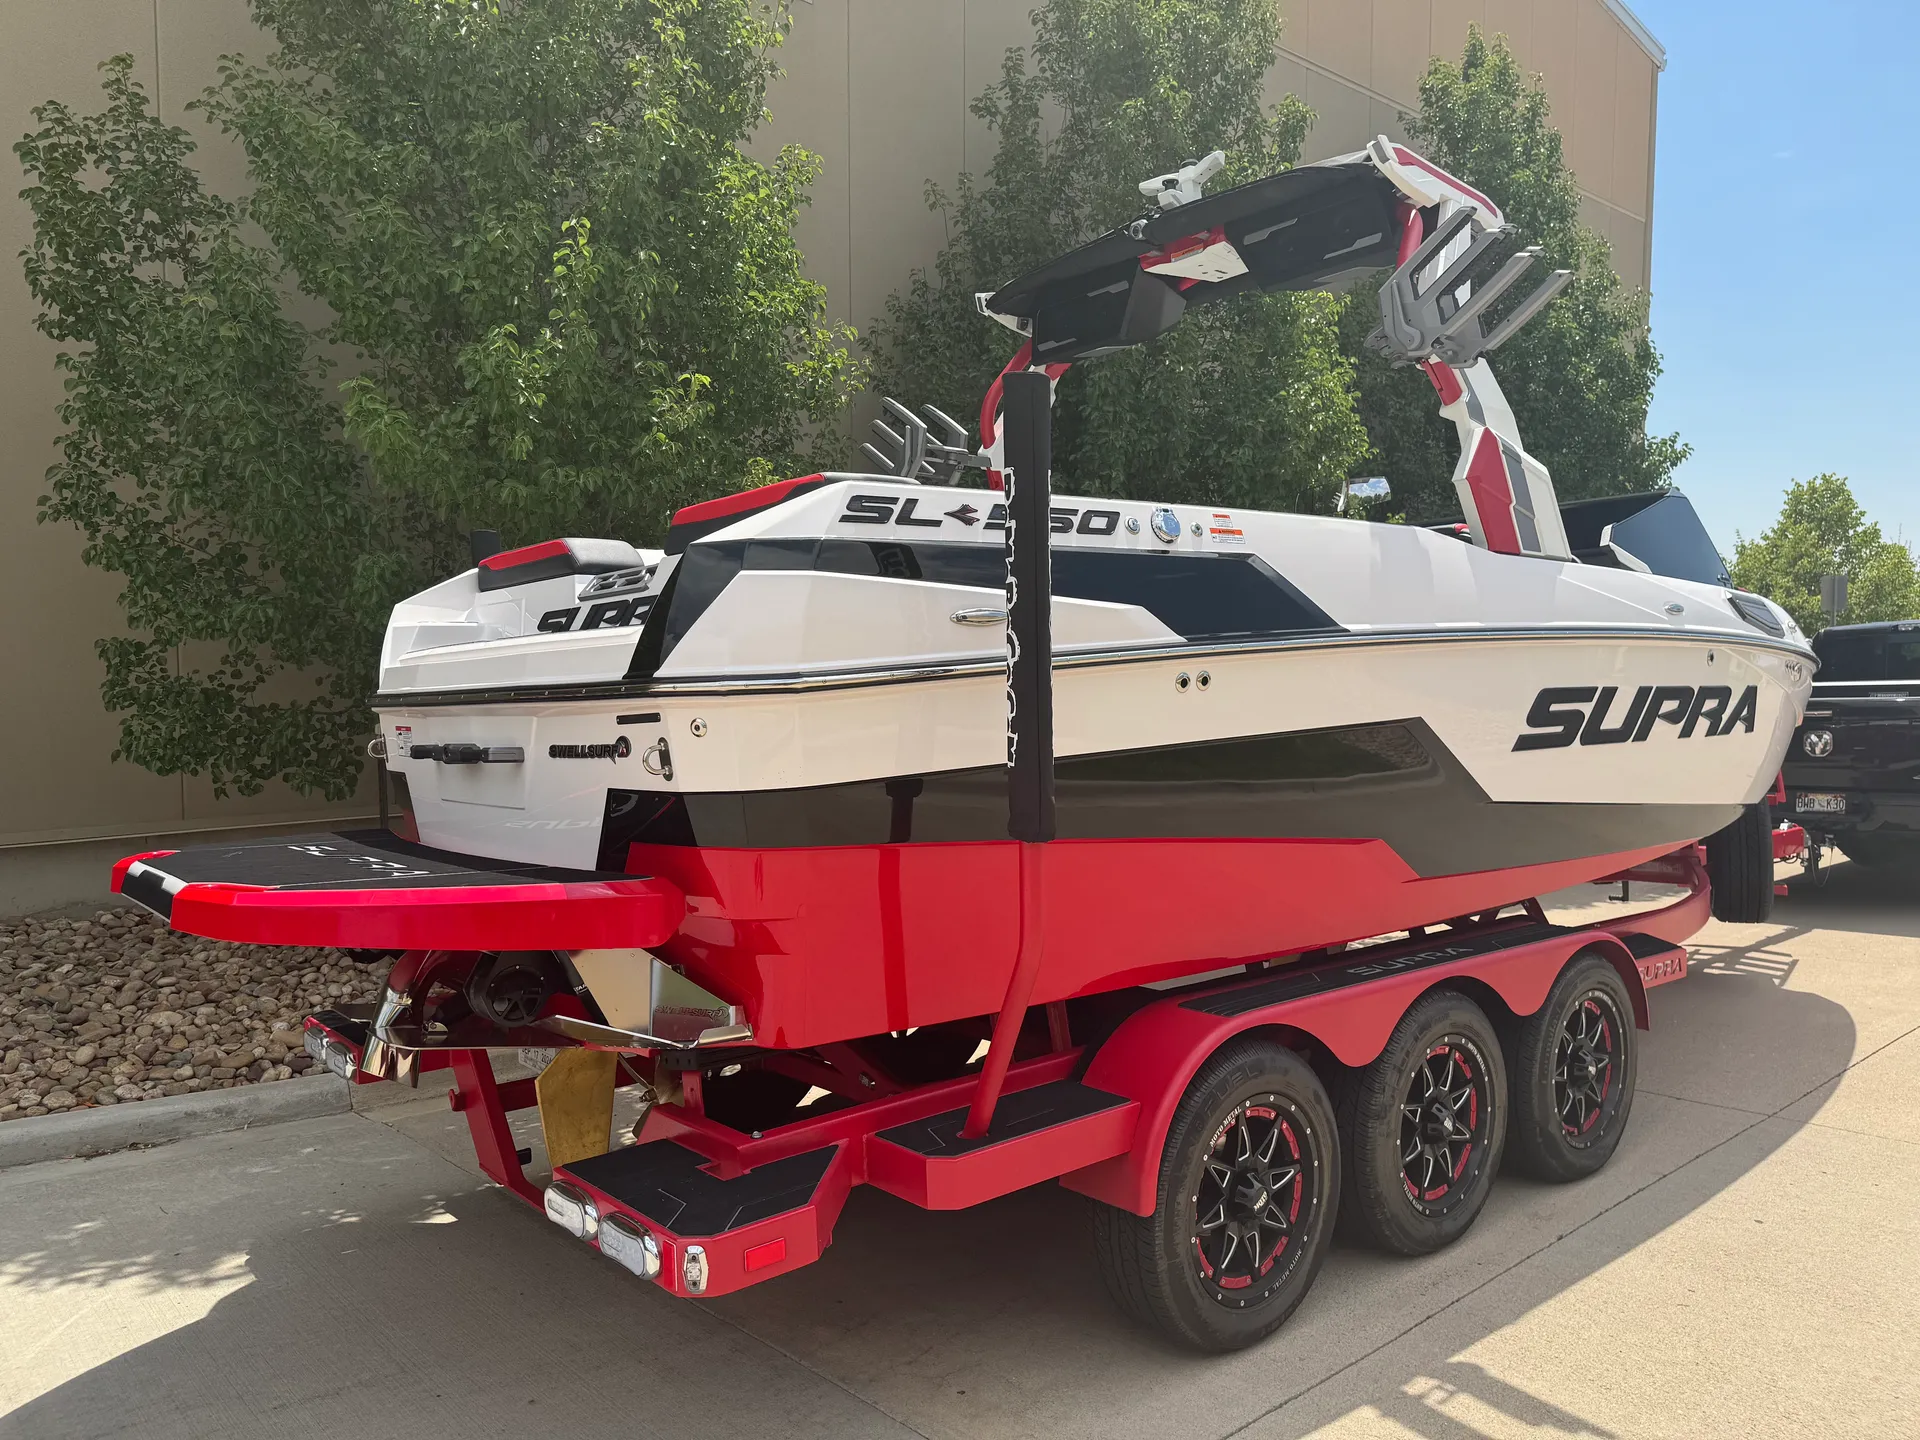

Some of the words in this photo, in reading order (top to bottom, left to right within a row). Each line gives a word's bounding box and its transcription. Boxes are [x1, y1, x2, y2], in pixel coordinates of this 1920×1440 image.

[838, 494, 943, 528] SL
[537, 594, 659, 633] SUPR
[1511, 685, 1758, 752] SUPRA
[1346, 946, 1474, 976] SUPRA
[1209, 1124, 1224, 1148] MOTO
[1223, 1105, 1242, 1127] METAL
